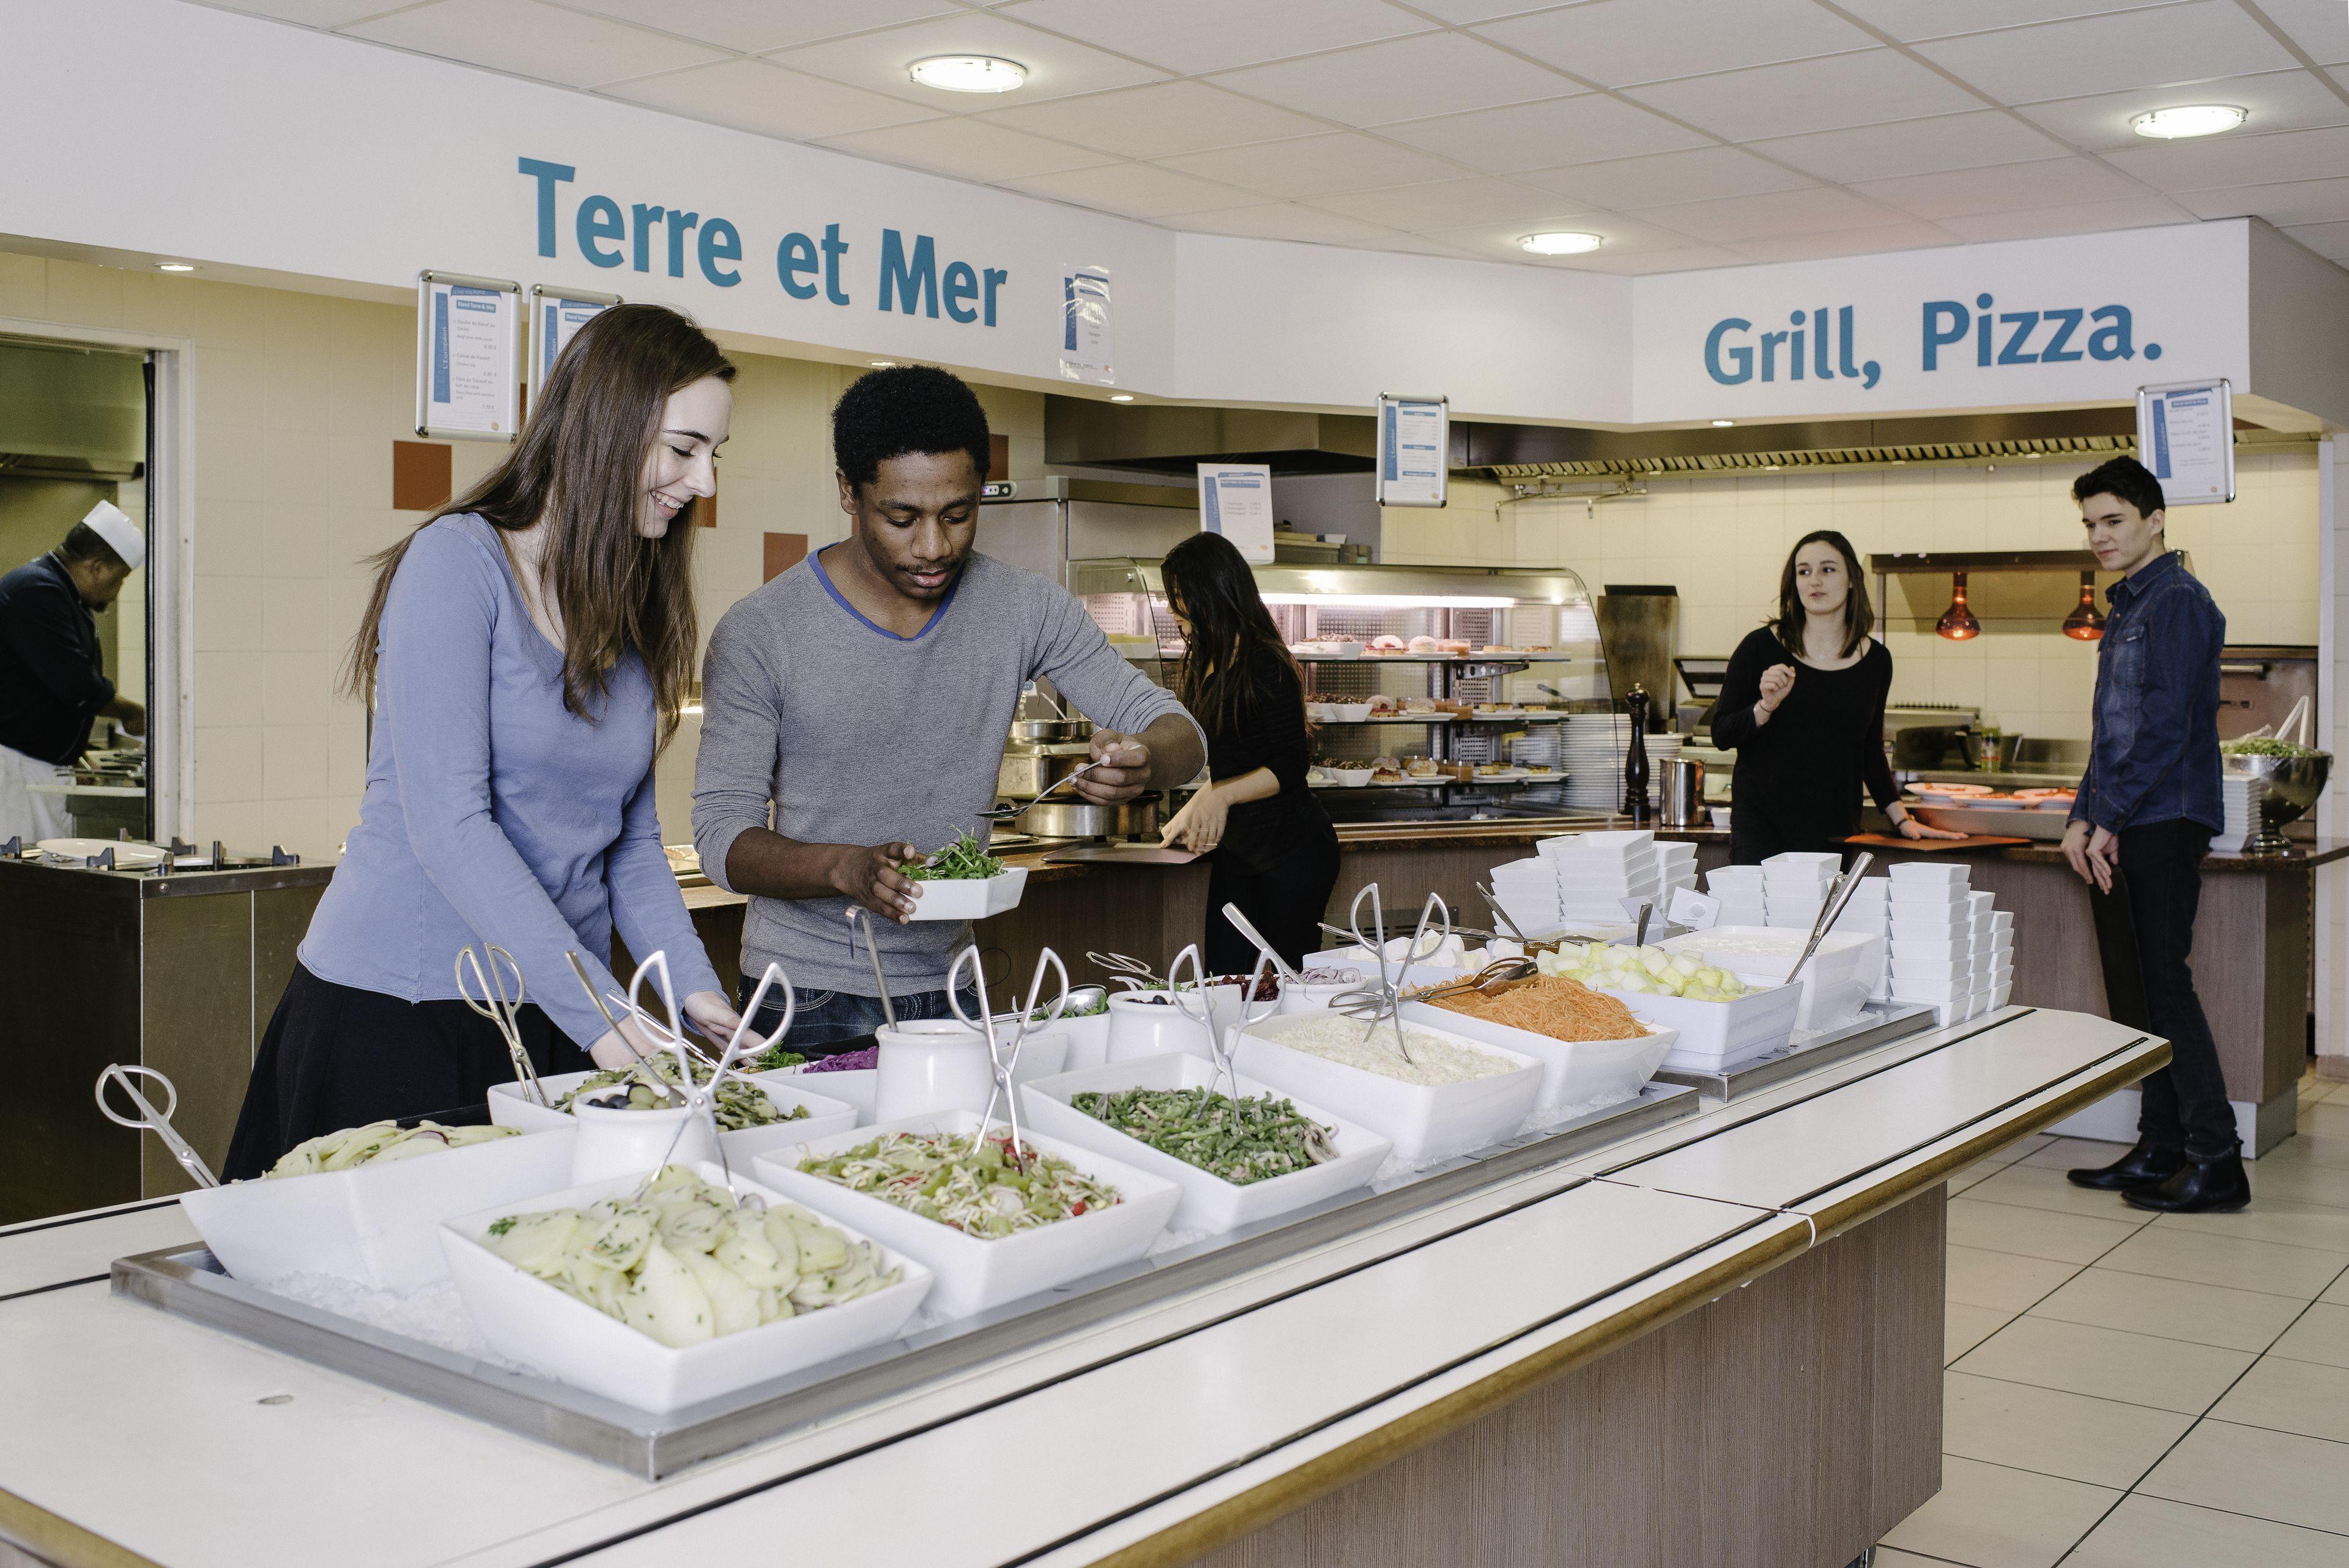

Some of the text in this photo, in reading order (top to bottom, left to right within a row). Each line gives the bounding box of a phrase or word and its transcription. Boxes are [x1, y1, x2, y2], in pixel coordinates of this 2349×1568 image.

[518, 157, 1007, 327] Terre et Mer
[1705, 292, 2162, 388] Grill, Pizza.
